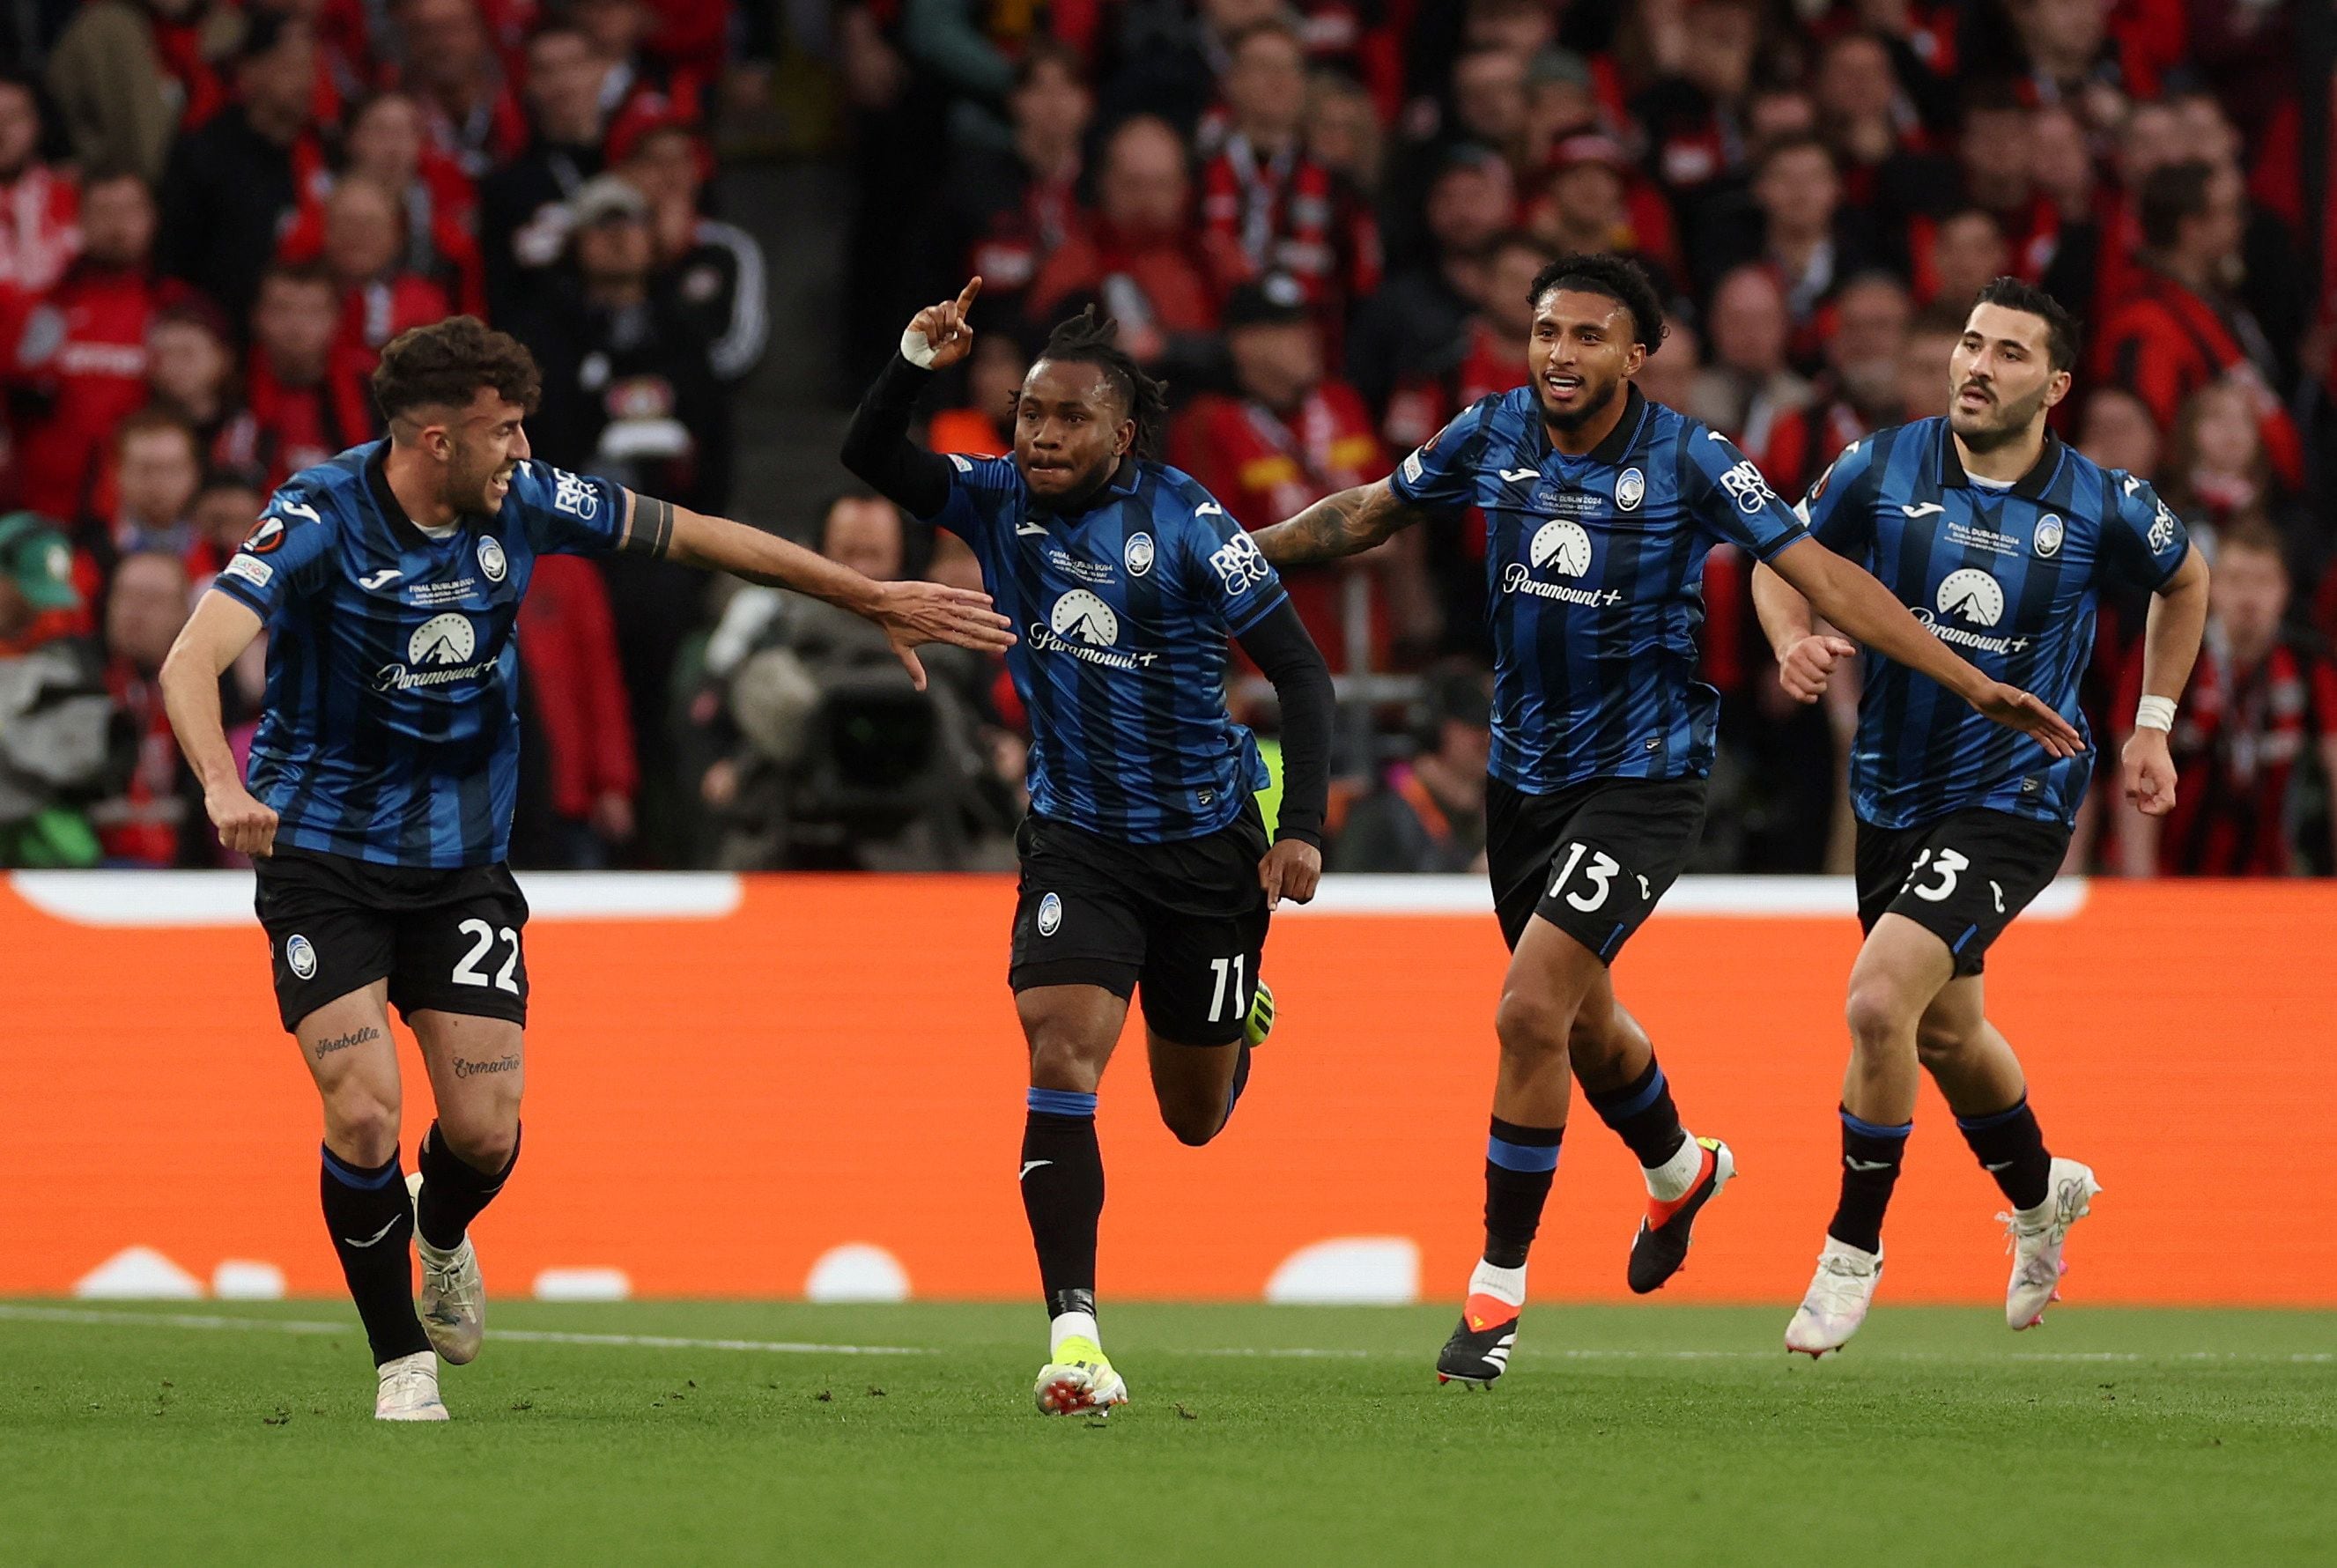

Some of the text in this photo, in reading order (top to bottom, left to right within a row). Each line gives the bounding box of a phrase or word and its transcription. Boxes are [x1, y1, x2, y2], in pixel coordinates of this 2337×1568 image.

[577, 482, 598, 520] GR
[1948, 521, 1970, 534] FINAL
[1971, 528, 2000, 540] DUBLIN
[1503, 563, 1622, 608] Paramount+
[1028, 623, 1158, 669] Paramount+
[372, 655, 499, 692] Paramount+
[1549, 842, 1621, 913] 13
[451, 918, 520, 995] 22
[1208, 952, 1245, 1023] 11
